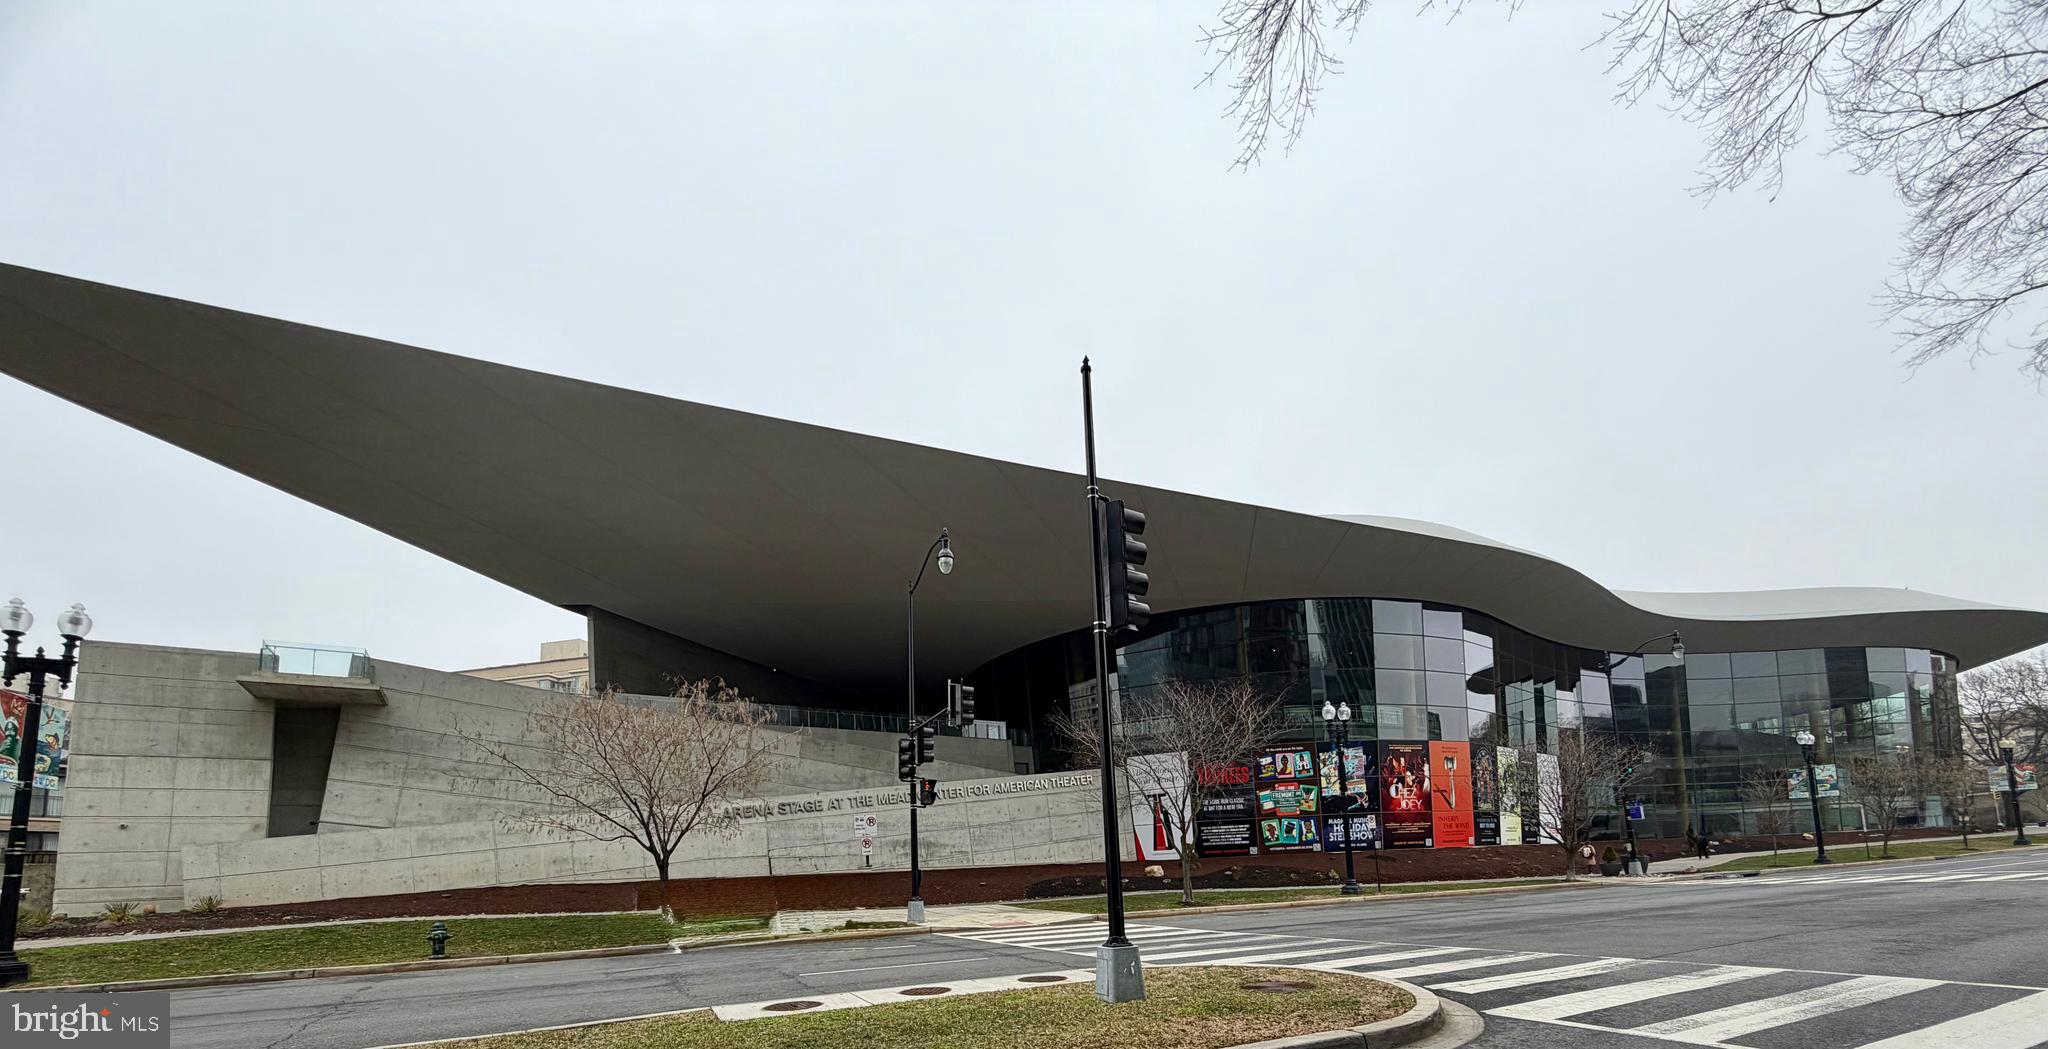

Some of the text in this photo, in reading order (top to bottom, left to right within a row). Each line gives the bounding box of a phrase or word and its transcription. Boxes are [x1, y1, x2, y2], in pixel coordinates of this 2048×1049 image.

[722, 802, 774, 820] ARENA
[777, 800, 824, 816] STAGE
[827, 798, 844, 811] AT
[846, 794, 874, 808] THE
[966, 783, 991, 798] FOR
[993, 778, 1049, 795] AMERICAN
[1050, 774, 1093, 789] THEATER
[1272, 790, 1295, 799] FREMONT
[1389, 783, 1417, 798] CHEZ
[1396, 799, 1423, 810] JOEY
